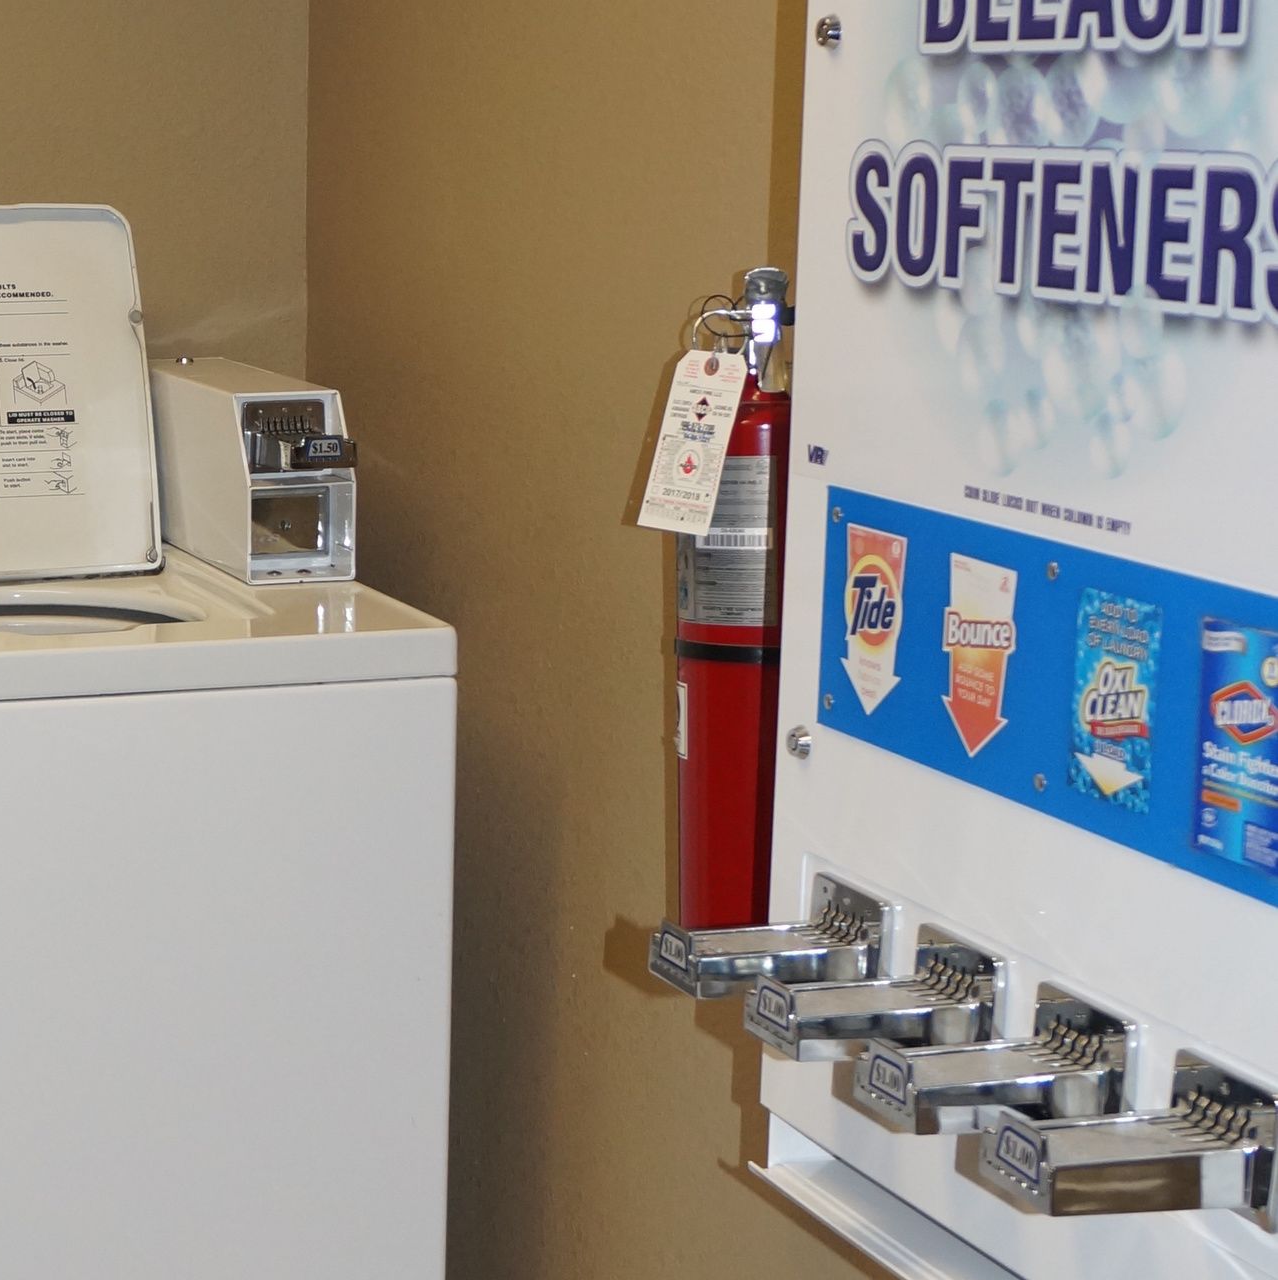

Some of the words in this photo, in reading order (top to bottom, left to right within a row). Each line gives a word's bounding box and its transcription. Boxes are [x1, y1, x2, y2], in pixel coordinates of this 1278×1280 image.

[312, 442, 338, 454] $1.50
[982, 488, 1000, 506] SLIDE
[850, 573, 897, 636] Tide
[947, 611, 1012, 648] Bounce
[1098, 661, 1134, 695] OXI
[1084, 688, 1146, 723] CLEAN
